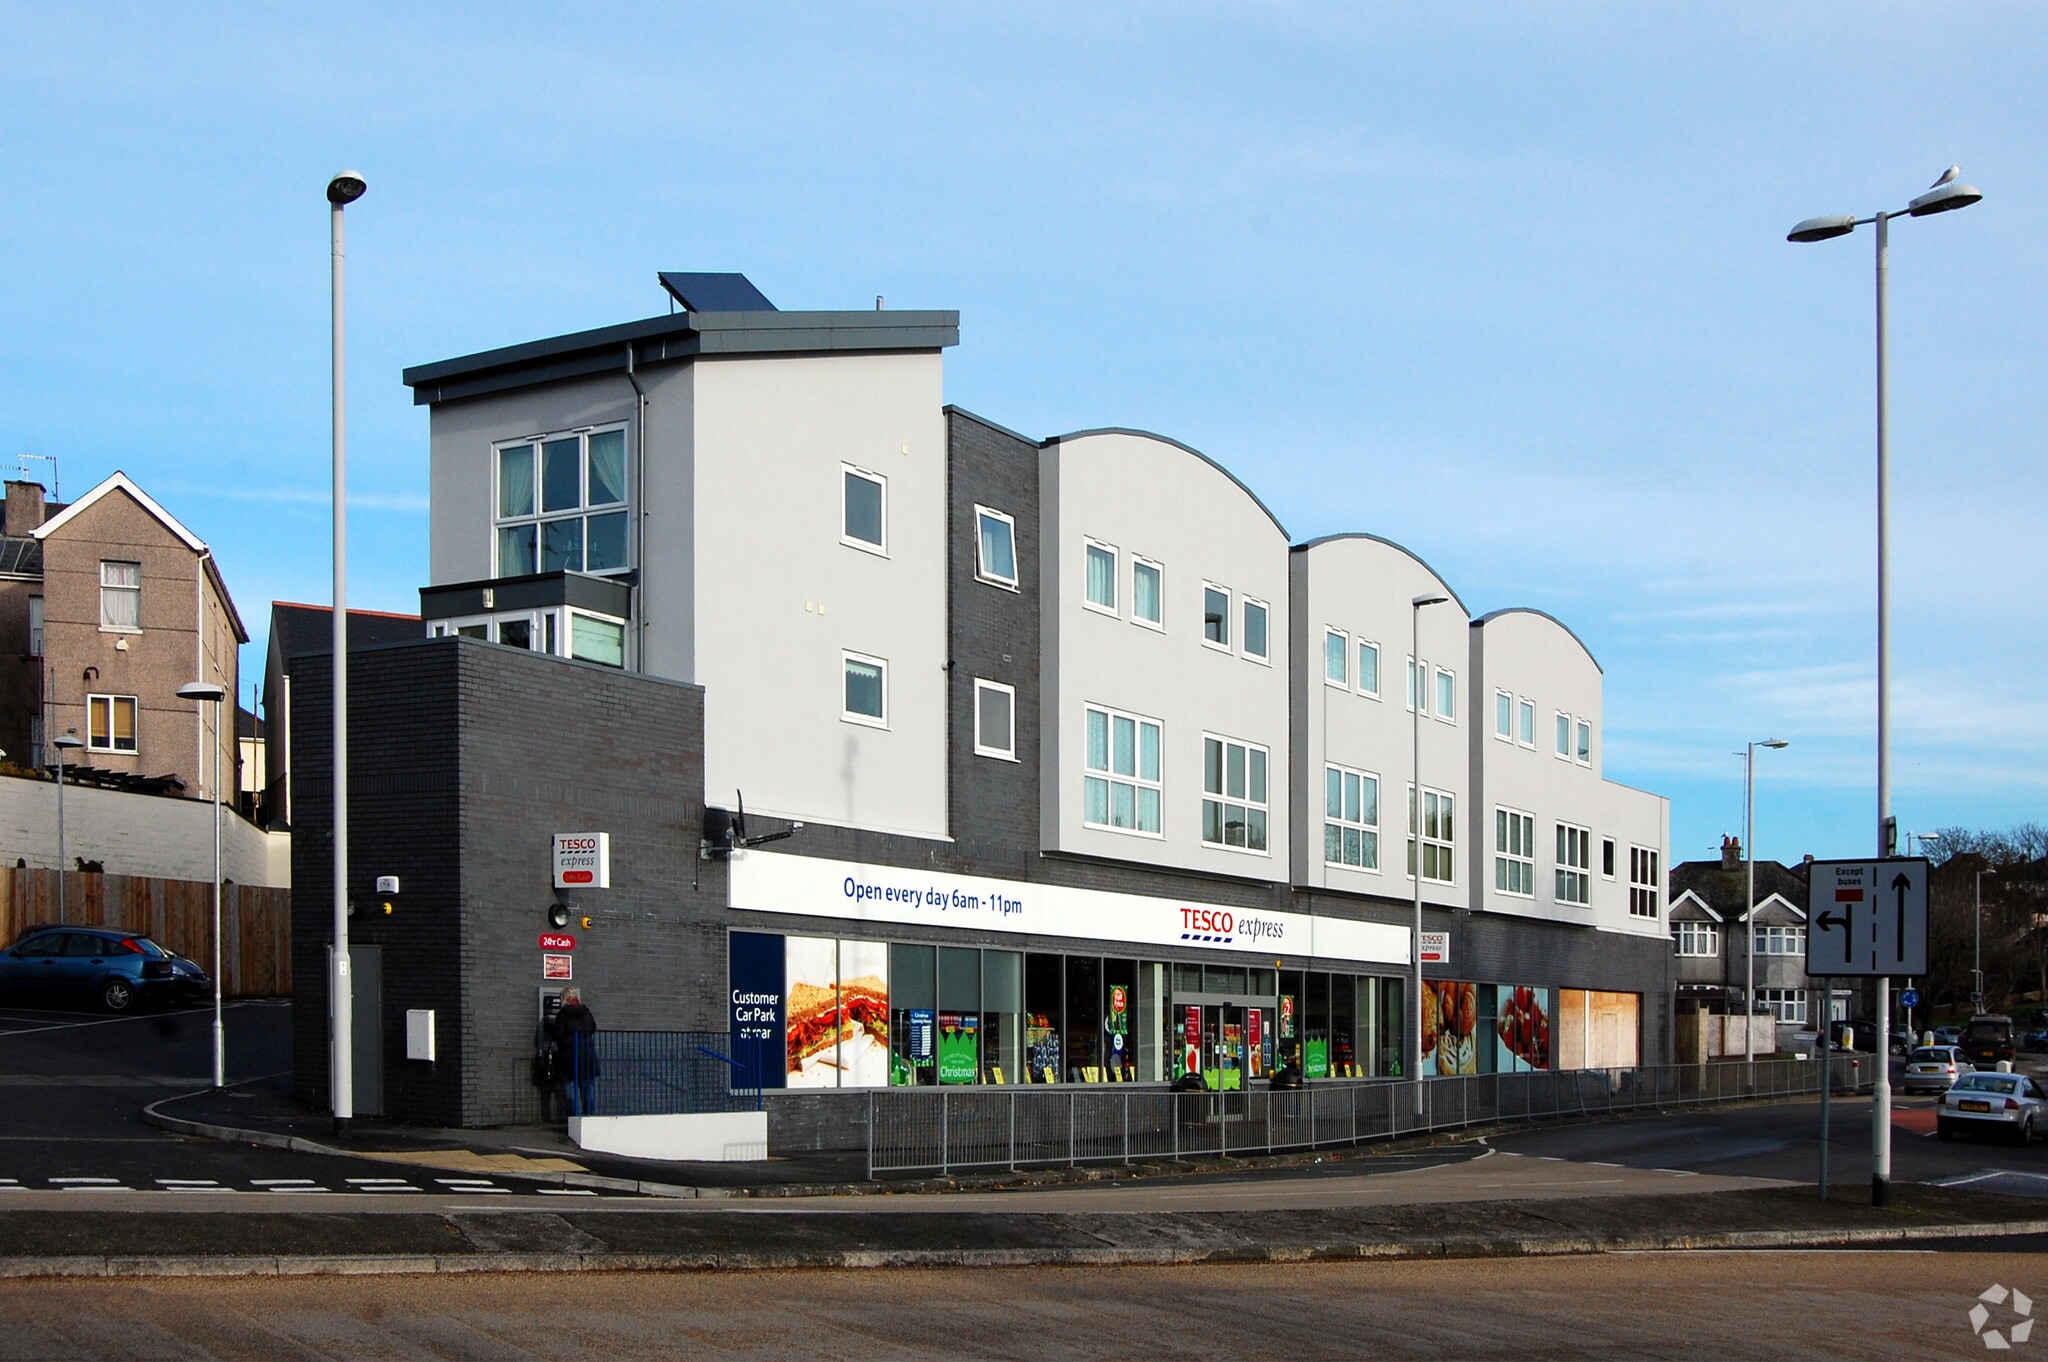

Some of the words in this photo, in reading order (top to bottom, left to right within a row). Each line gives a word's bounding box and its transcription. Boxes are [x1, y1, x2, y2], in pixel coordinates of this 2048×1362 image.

[559, 838, 596, 849] TESCO
[560, 855, 595, 869] express
[1835, 867, 1864, 876] Except
[1837, 878, 1862, 886] buses
[844, 877, 882, 903] Open
[885, 887, 922, 909] every
[926, 886, 949, 911] day
[952, 889, 979, 909] 6am
[989, 893, 1022, 917] 11pm
[1180, 907, 1233, 933] TESCO
[1238, 917, 1284, 943] express
[543, 936, 556, 946] 24hr
[556, 938, 571, 947] Cash
[732, 989, 779, 1005] Customer
[735, 1007, 752, 1021] Car
[754, 1007, 776, 1022] Park
[940, 1065, 975, 1078] Christmas
